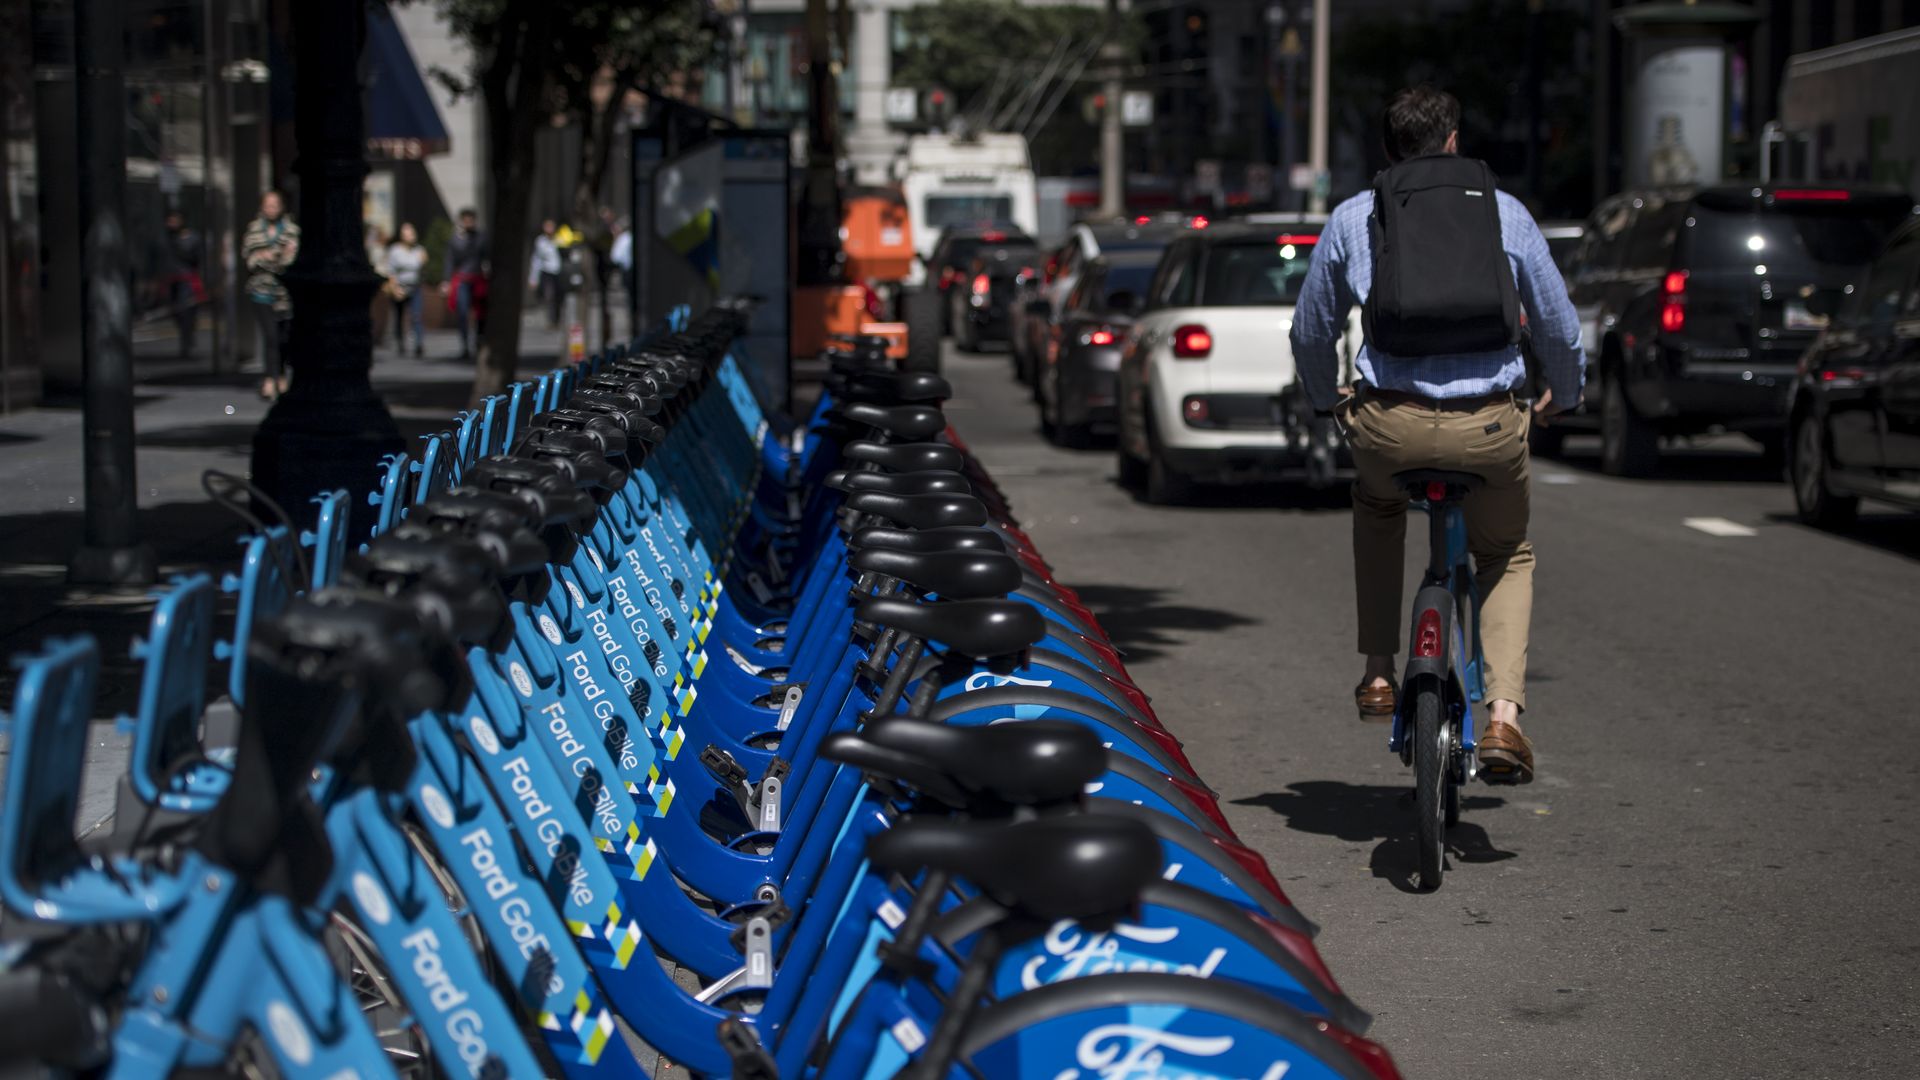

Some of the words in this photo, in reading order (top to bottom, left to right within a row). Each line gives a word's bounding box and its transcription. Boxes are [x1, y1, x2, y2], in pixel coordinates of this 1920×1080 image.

[587, 608, 623, 656] Ford
[611, 653, 653, 718] GoBike
[608, 575, 641, 619] Ford
[631, 617, 668, 678] GoBike
[541, 701, 586, 758] Ford
[573, 756, 622, 835] GoBike
[565, 649, 606, 701] Ford
[593, 700, 638, 771] GoBike
[501, 755, 553, 821] Ford
[536, 818, 594, 907] GoBike
[400, 927, 470, 1013] Ford
[461, 826, 518, 901] Ford
[499, 896, 565, 998] GoBe
